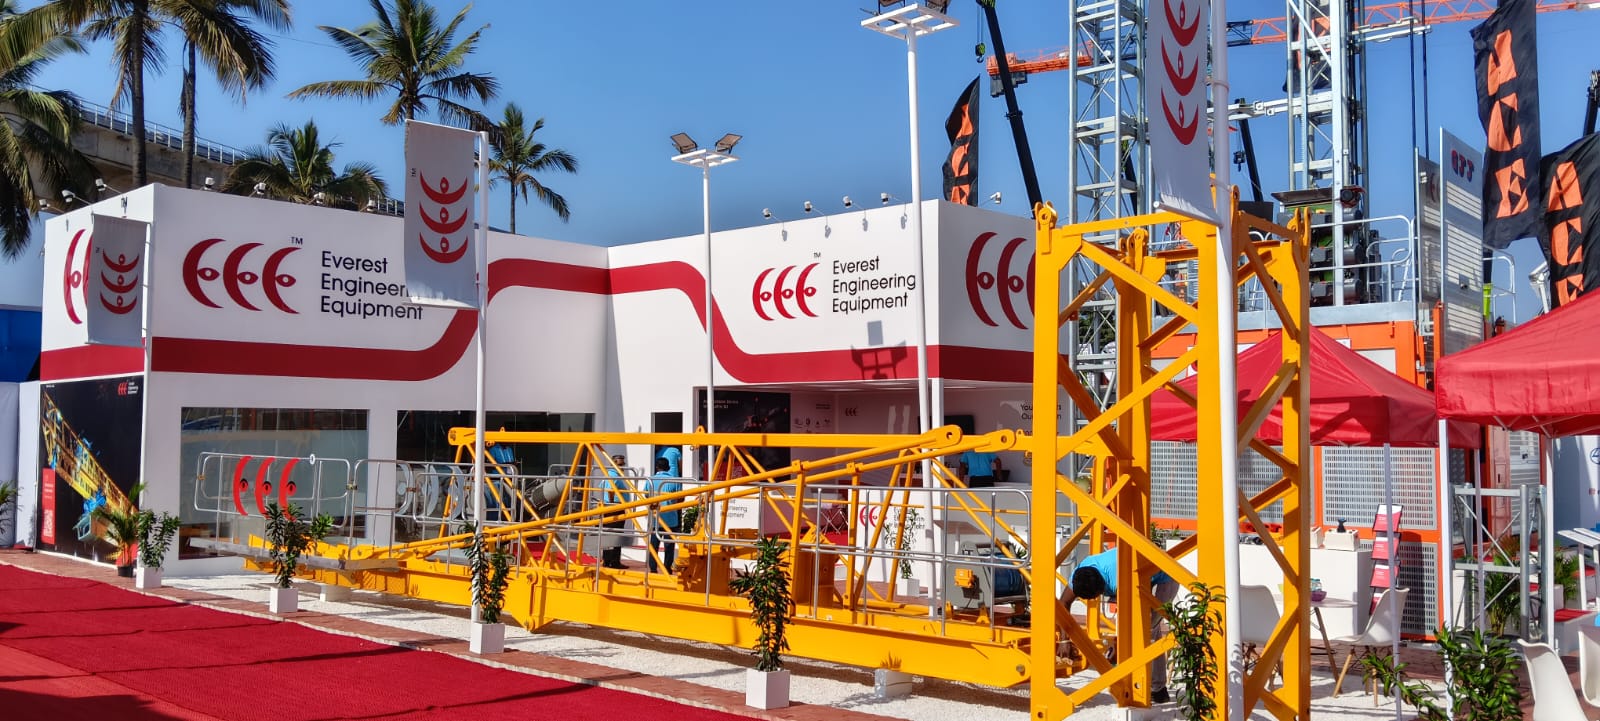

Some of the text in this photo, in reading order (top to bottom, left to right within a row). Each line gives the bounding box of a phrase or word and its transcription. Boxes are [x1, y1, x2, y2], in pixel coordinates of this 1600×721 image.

[1487, 29, 1529, 219] ACE
[321, 250, 388, 274] Everest
[833, 255, 880, 275] Everest
[321, 273, 411, 298] Engineer
[833, 273, 917, 296] Engineering
[321, 295, 423, 320] Equipment
[832, 292, 908, 315] Equipment
